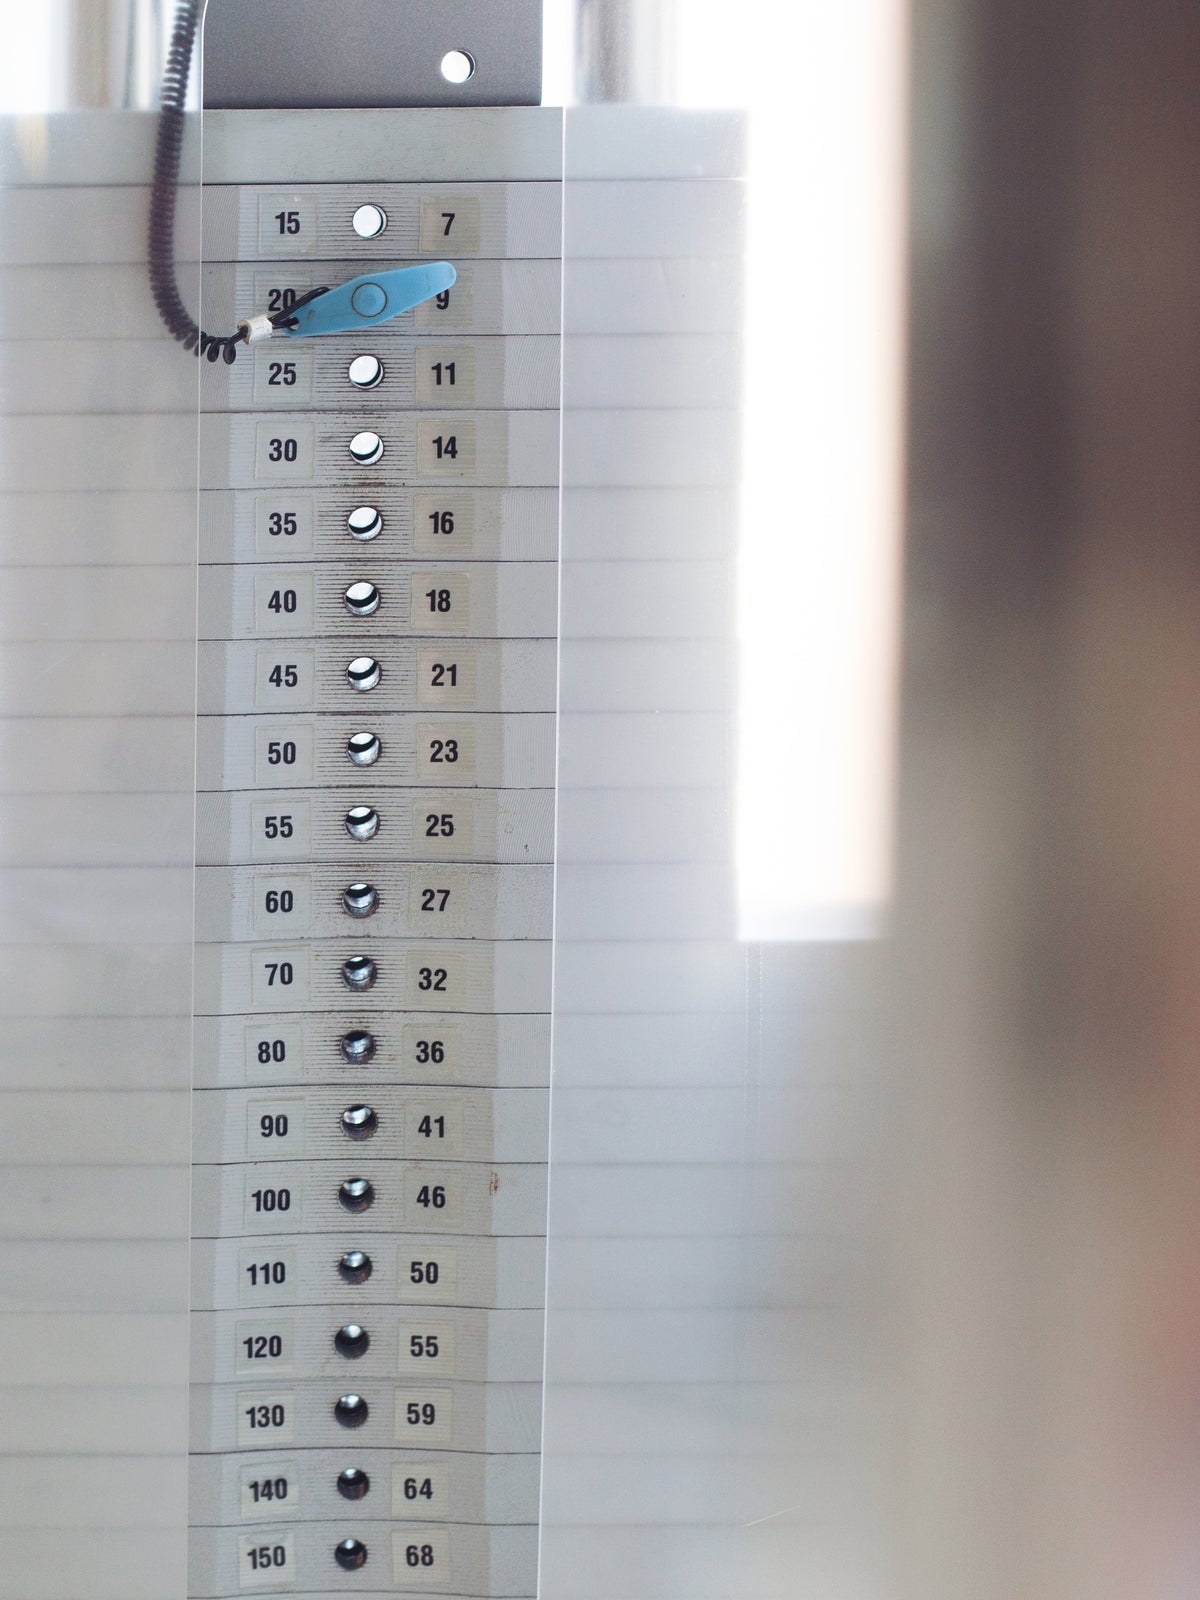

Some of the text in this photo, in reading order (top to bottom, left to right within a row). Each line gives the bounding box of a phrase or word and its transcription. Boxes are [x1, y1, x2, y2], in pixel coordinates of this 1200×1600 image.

[274, 211, 301, 235] 15
[441, 212, 456, 237] 7
[267, 288, 297, 312] 20
[435, 288, 450, 311] 9
[268, 362, 297, 386] 25
[430, 361, 456, 386] 11
[268, 438, 298, 462] 30
[431, 435, 459, 460] 14
[268, 512, 298, 536] 35
[428, 510, 455, 535] 16
[267, 589, 297, 614] 40
[425, 588, 452, 613] 18
[268, 664, 298, 688] 45
[430, 663, 457, 687] 21
[267, 741, 297, 765] 50
[429, 739, 459, 763] 23
[264, 815, 294, 839] 55
[425, 813, 455, 838] 25
[265, 889, 294, 914] 60
[420, 888, 451, 912] 27
[264, 962, 294, 987] 70
[418, 967, 448, 992] 32
[257, 1039, 286, 1064] 80
[415, 1040, 445, 1064] 36
[260, 1114, 289, 1138] 90
[417, 1114, 445, 1139] 41
[251, 1188, 291, 1213] 100
[415, 1185, 446, 1209] 46
[246, 1261, 286, 1286] 110
[410, 1261, 439, 1285] 50
[242, 1334, 282, 1359] 120
[410, 1334, 439, 1358] 55
[245, 1404, 285, 1429] 130
[406, 1402, 436, 1426] 59
[248, 1477, 288, 1503] 140
[403, 1477, 434, 1500] 64
[247, 1545, 286, 1570] 150
[405, 1544, 435, 1568] 68
